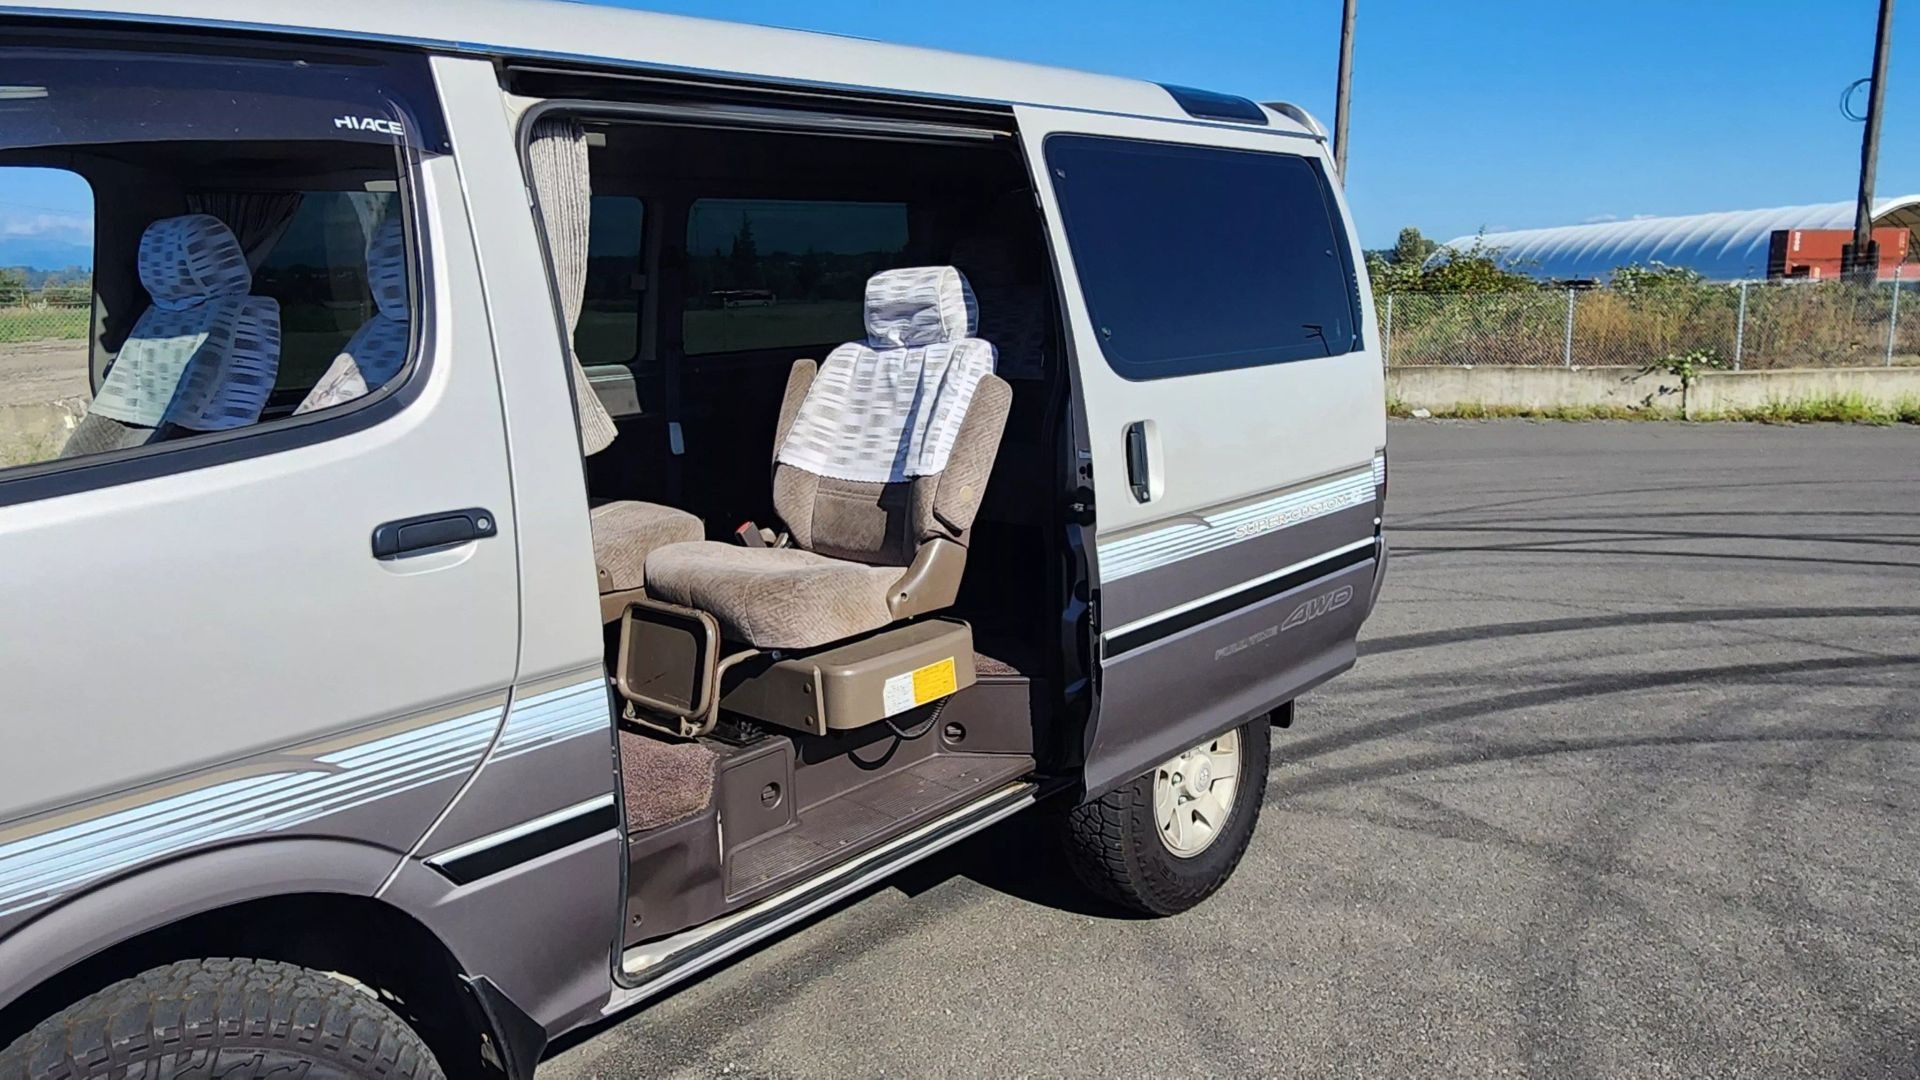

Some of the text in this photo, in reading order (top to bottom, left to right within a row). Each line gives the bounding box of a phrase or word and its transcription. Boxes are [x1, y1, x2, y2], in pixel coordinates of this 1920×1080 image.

[334, 116, 404, 135] HIACE
[1234, 512, 1288, 538] SUPER
[1290, 494, 1348, 520] CUSTOM
[1281, 585, 1353, 631] 4WD
